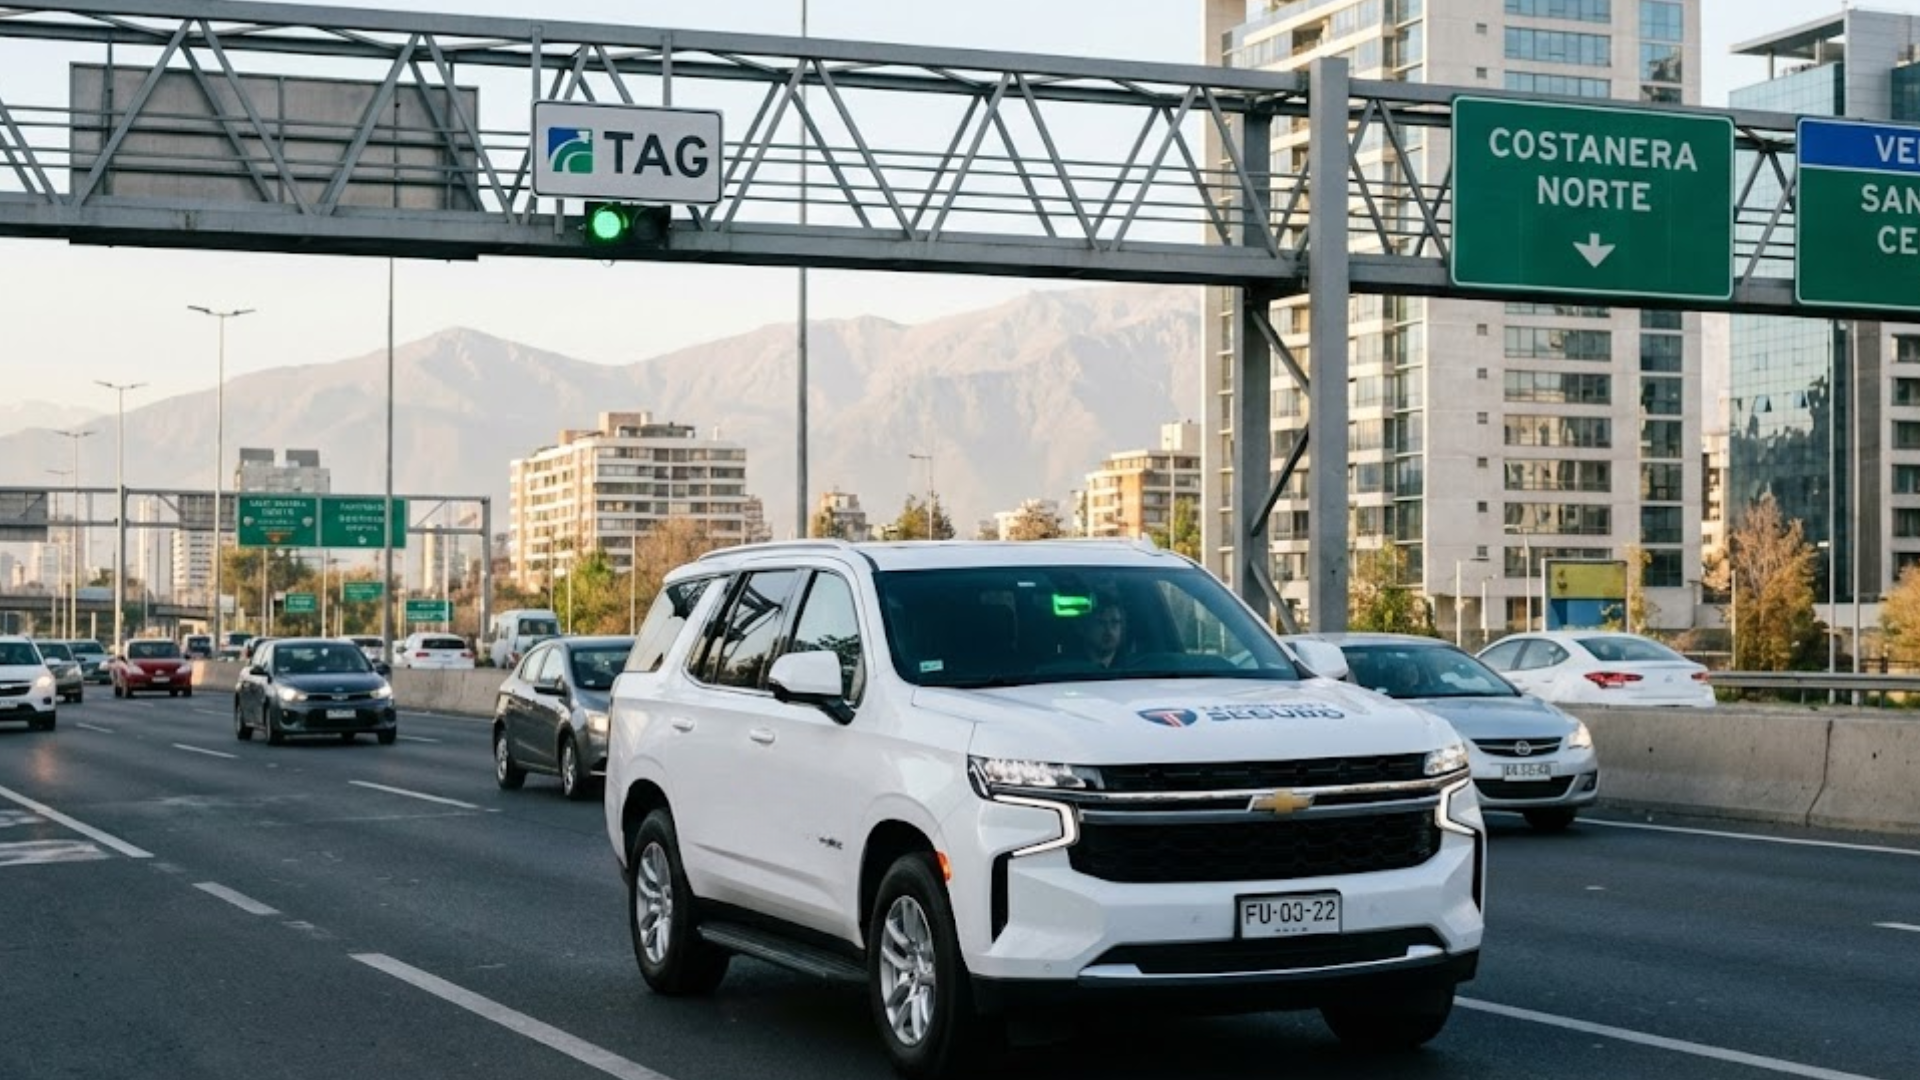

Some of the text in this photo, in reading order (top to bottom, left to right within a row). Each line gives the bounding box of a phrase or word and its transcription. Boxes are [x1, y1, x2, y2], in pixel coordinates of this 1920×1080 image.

[603, 131, 708, 178] TAG
[1488, 127, 1698, 172] COSTANERA
[1874, 135, 1920, 165] VE
[1537, 175, 1652, 212] NORTE
